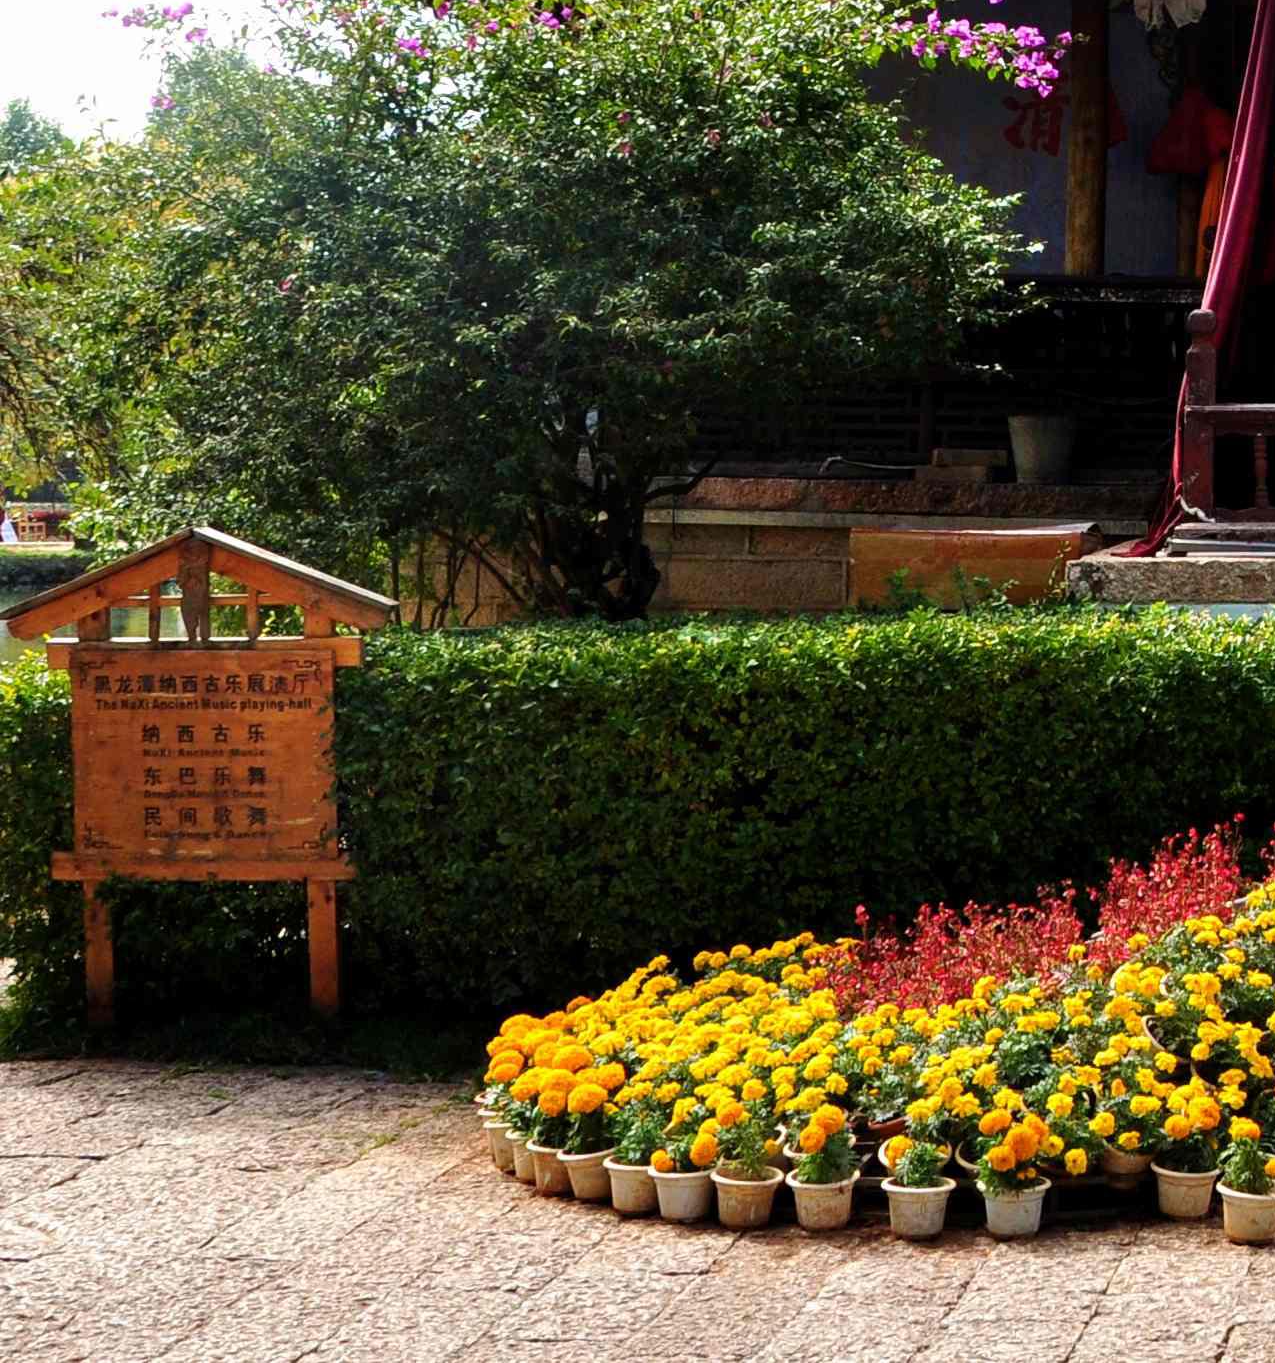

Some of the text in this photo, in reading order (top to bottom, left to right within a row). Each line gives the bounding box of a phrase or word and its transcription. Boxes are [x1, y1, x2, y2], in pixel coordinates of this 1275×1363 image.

[96, 699, 118, 710] The
[152, 698, 199, 710] Ancient
[201, 698, 237, 710] Music
[142, 724, 266, 743] 纳西古乐
[143, 766, 266, 786] 东巴乐舞
[144, 806, 268, 828] 民间歌舞
